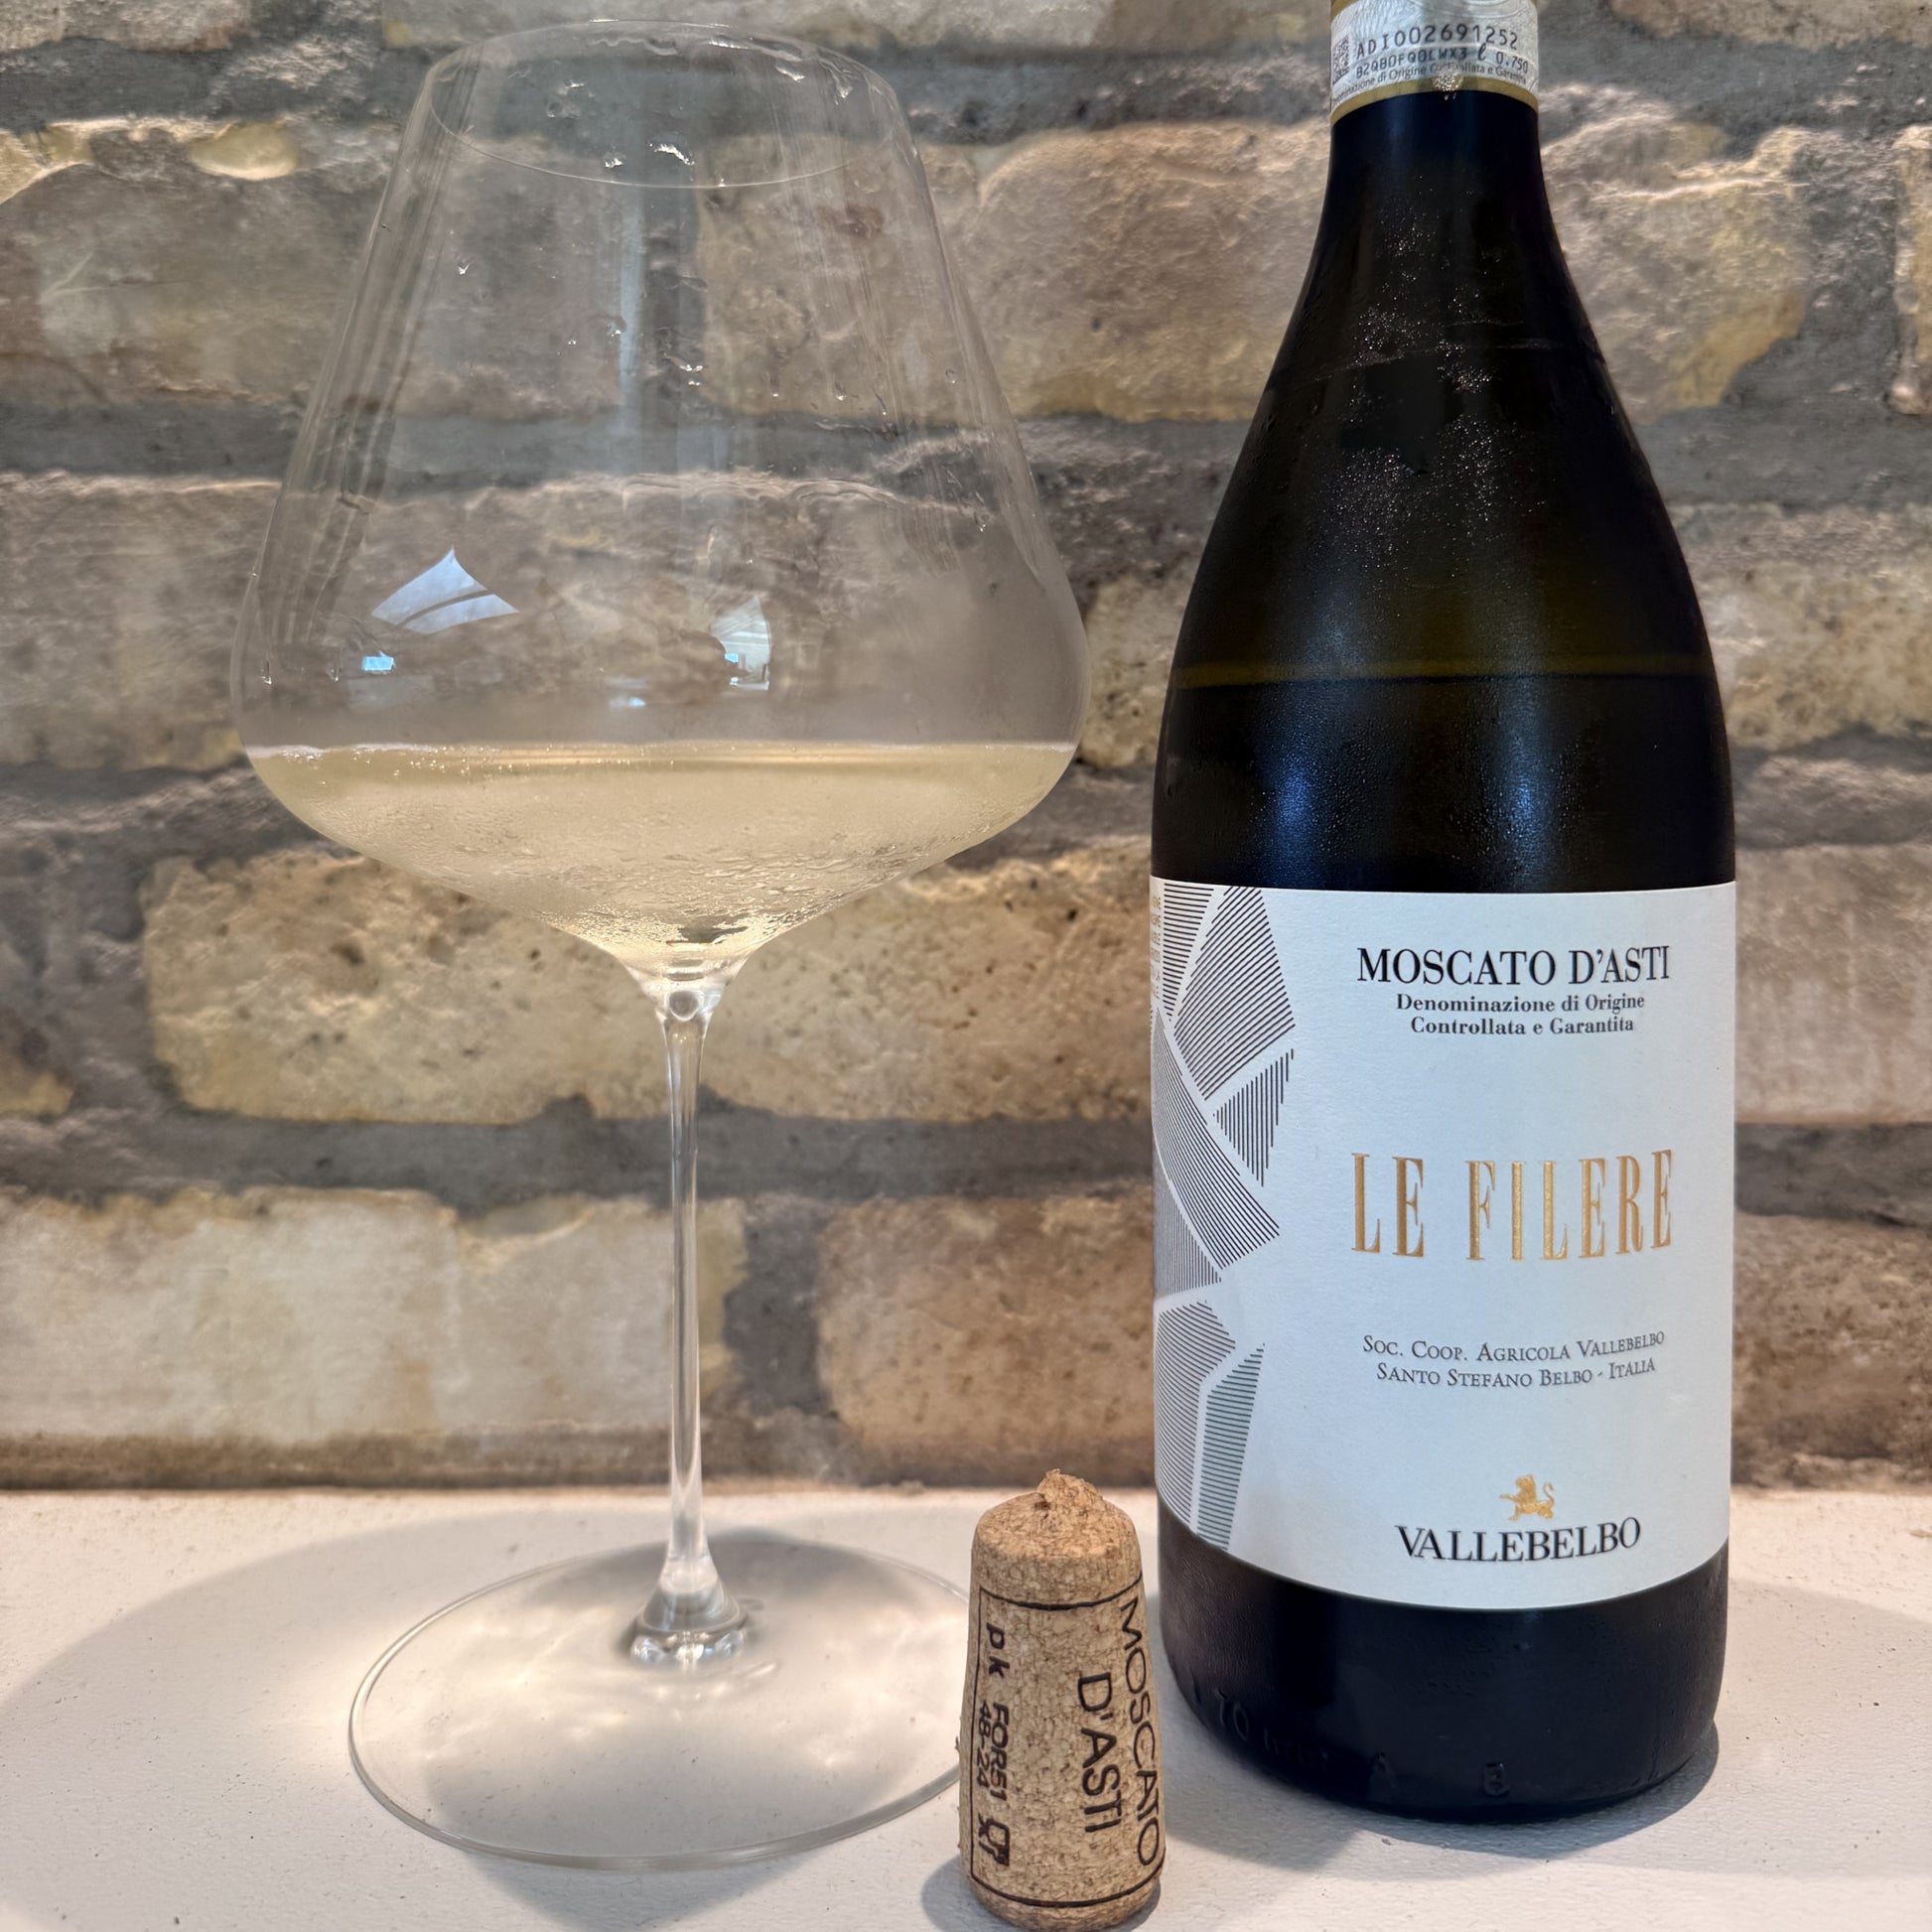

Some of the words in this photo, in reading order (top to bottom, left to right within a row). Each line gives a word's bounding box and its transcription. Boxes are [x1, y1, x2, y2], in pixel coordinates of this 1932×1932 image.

[1389, 65, 1427, 81] Origine
[1496, 53, 1529, 74] 0.750
[1357, 947, 1556, 986] MOSCATO
[1569, 945, 1670, 985] D'ASTI
[1397, 993, 1555, 1013] Denominazione
[1561, 994, 1580, 1012] di
[1585, 994, 1645, 1014] Origine
[1411, 1016, 1526, 1035] Controllata
[1533, 1021, 1543, 1035] e
[1550, 1017, 1634, 1035] Garantita
[1351, 1152, 1425, 1258] LE
[1465, 1149, 1672, 1262] FILERE
[1476, 1342, 1572, 1361] AGRICOLA
[1577, 1330, 1665, 1358] VALLEBELBO
[1377, 1362, 1441, 1386] SANTO
[1448, 1369, 1533, 1388] STEFANO
[1540, 1369, 1592, 1387] BELBO
[1609, 1357, 1656, 1379] ITALIA
[1395, 1516, 1641, 1564] VALLEBELBO
[976, 1699, 993, 1788] 48-24
[1120, 1596, 1161, 1865] MOSCATO
[1078, 1671, 1123, 1833] D'ASTI
